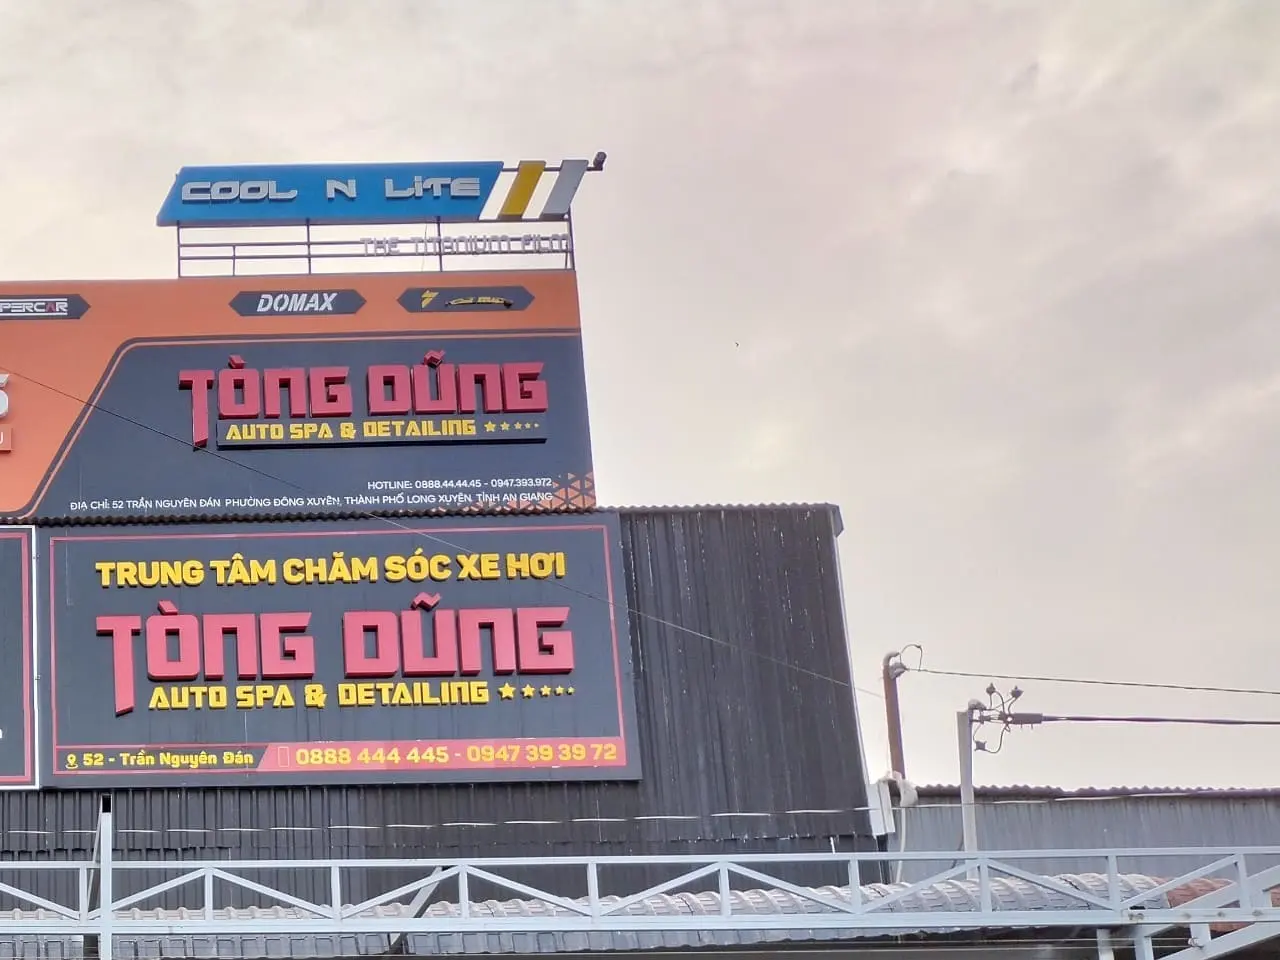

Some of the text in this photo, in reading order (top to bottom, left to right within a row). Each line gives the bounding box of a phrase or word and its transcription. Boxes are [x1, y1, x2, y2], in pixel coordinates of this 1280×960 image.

[181, 179, 298, 204] COOL
[326, 178, 357, 200] N
[359, 237, 400, 256] THE
[256, 292, 339, 313] DOMAX
[225, 419, 477, 441] AUTO SPA & DETAILING
[367, 480, 413, 490] HOTLINE:
[414, 479, 482, 490] 0888.44.44.45
[490, 477, 553, 488] 0947.393.972
[112, 500, 125, 510] 52
[155, 496, 197, 509] NGUYÊN
[407, 493, 436, 504] LONG
[95, 547, 566, 589] TRUNG TÂM CHĂM SÓC XE HƠI
[148, 680, 490, 710] AUTO SPA & DETAILING
[82, 753, 105, 767] 52
[119, 748, 156, 767] Trần
[159, 752, 218, 768] Nguyên
[222, 748, 254, 765] Đán
[295, 746, 352, 766] 0888
[356, 745, 404, 764] 444
[409, 745, 450, 764] 445
[466, 744, 521, 763] 0947
[523, 744, 555, 762] 39
[557, 744, 586, 762] 39
[588, 742, 617, 761] 72
